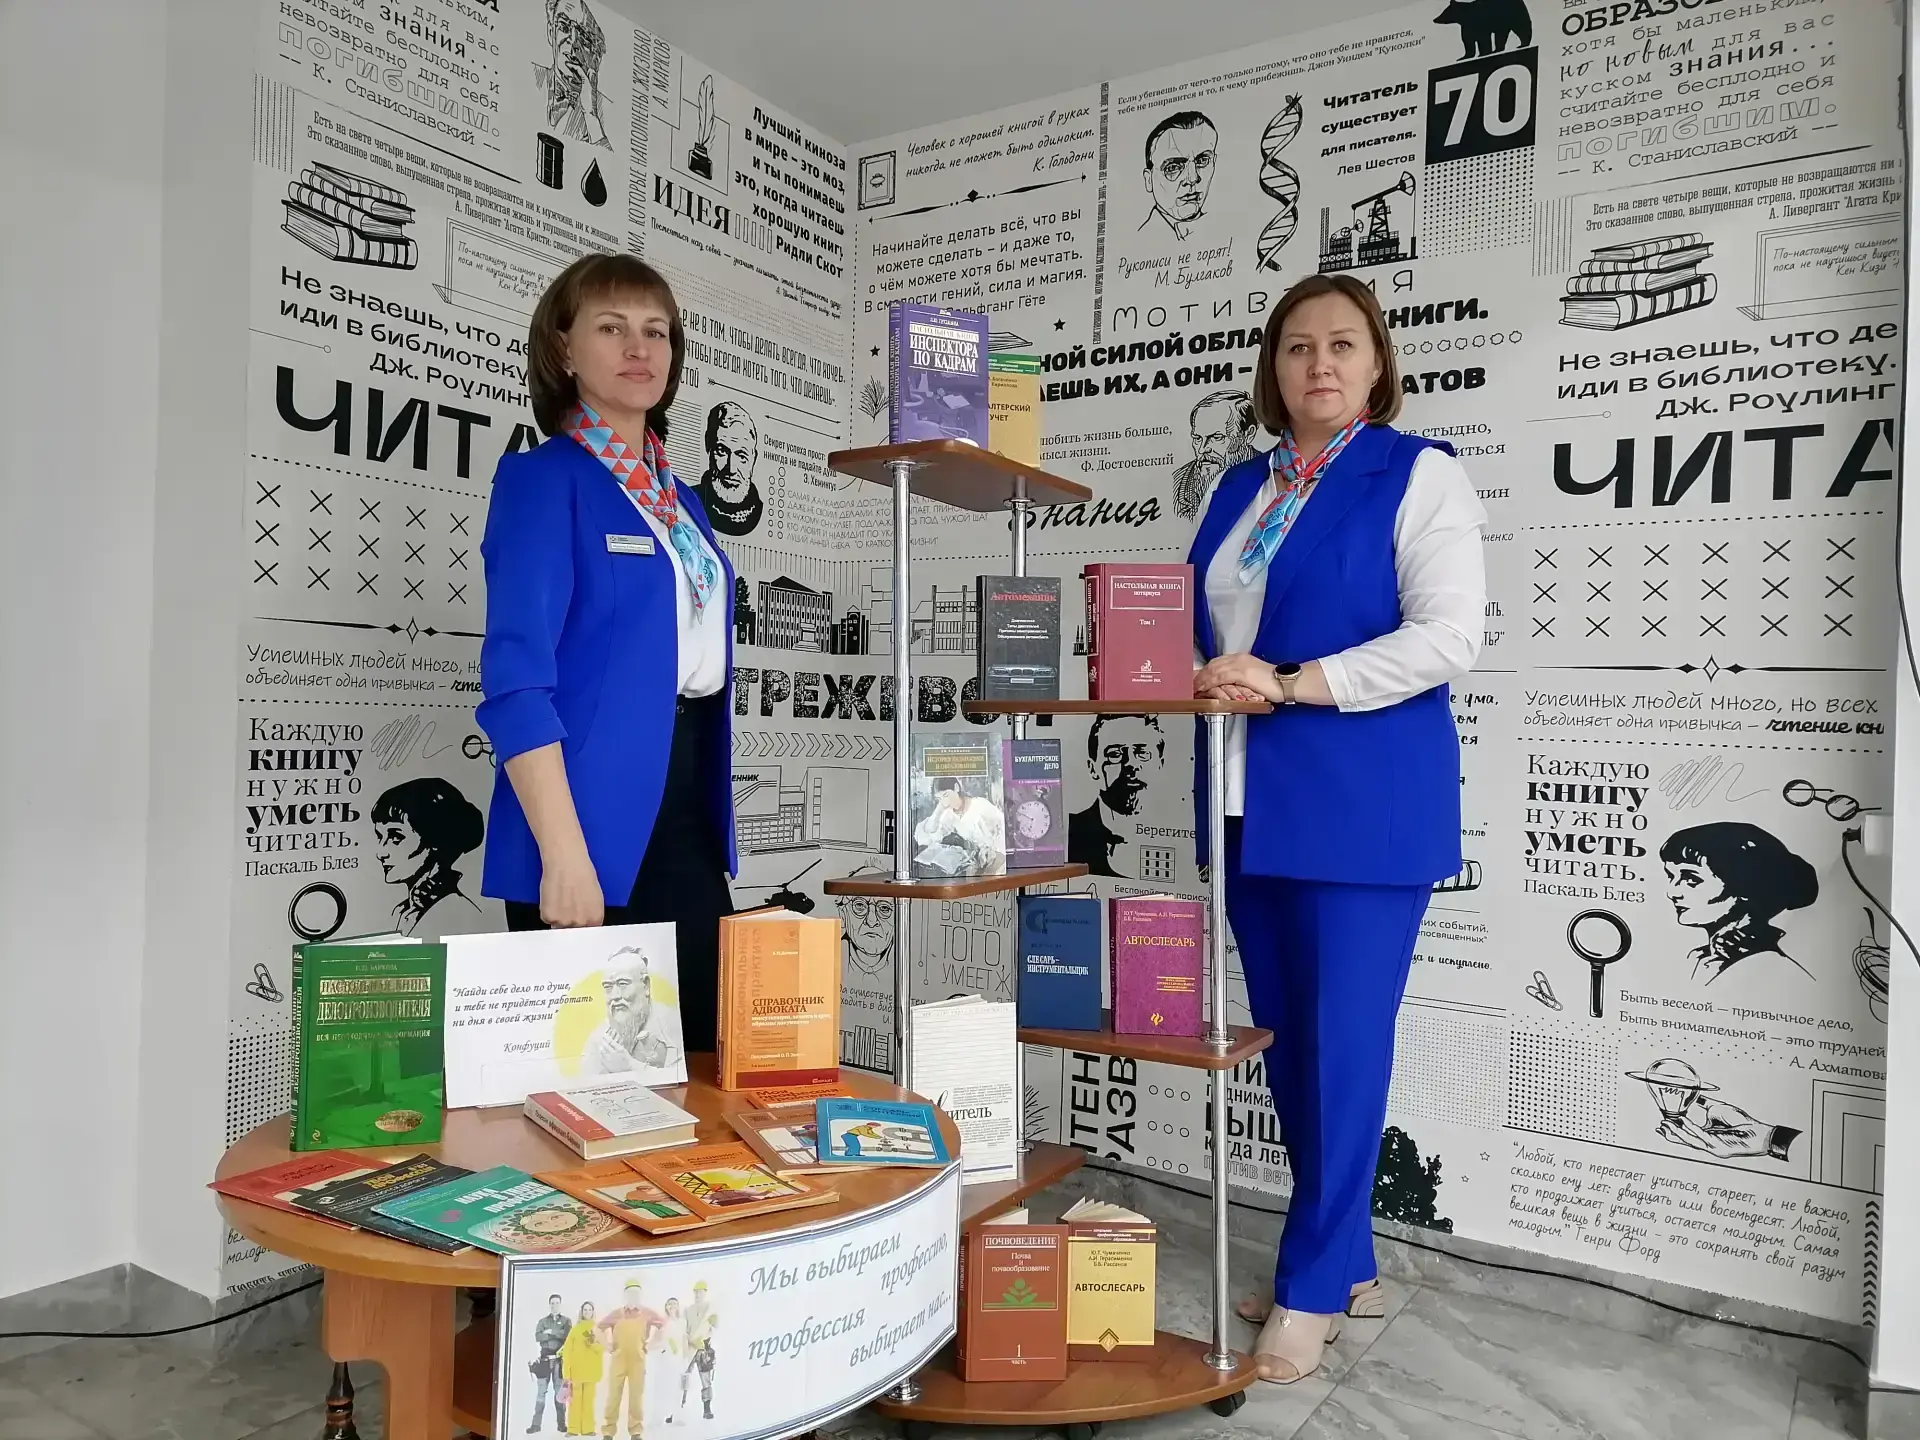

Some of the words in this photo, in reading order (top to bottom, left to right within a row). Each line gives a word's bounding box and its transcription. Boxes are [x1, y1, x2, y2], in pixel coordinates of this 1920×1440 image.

[1323, 80, 1418, 110] Читатель
[1559, 88, 1663, 118] считайте
[1678, 59, 1805, 95] бесплодно
[1821, 54, 1835, 68] и
[1560, 72, 1651, 99] куском
[1321, 104, 1418, 134] существует
[1435, 64, 1532, 147] 70
[753, 106, 801, 146] Лучший
[908, 140, 946, 157] Человек
[950, 139, 955, 147] с
[959, 125, 1004, 147] хорошей
[1008, 116, 1044, 133] книгой
[1048, 109, 1055, 125] в
[1057, 107, 1090, 125] руках
[1558, 97, 1837, 162] погибшим.
[906, 160, 946, 177] никогда
[949, 158, 961, 167] не
[964, 149, 1001, 164] может
[1006, 141, 1034, 155] быть
[1038, 128, 1094, 150] одиноким.
[1321, 143, 1345, 158] для
[1349, 130, 1417, 153] писателя.
[1592, 160, 1613, 174] К.
[1628, 125, 1798, 168] Станиславский
[1033, 157, 1044, 172] К.
[1049, 150, 1094, 169] Гольдони
[1337, 161, 1362, 177] Лев
[1365, 152, 1416, 172] Шестов
[653, 173, 731, 236] ИДЕЯ
[1769, 208, 1779, 219] А.
[1783, 201, 1839, 217] Ливергант
[753, 203, 809, 241] хорошую
[872, 234, 943, 256] Начинайте
[948, 225, 995, 244] делать
[1001, 217, 1028, 233] всё,
[1033, 213, 1055, 227] что
[1062, 208, 1081, 221] вы
[776, 235, 812, 265] Ридли
[1118, 255, 1172, 276] Рукописи
[1177, 252, 1191, 265] не
[1196, 237, 1233, 268] горят!
[1155, 271, 1171, 287] М.
[1174, 260, 1233, 290] Булгаков
[281, 265, 322, 294] Не
[330, 283, 449, 335] знаешь,
[455, 321, 500, 346] что
[1018, 293, 1046, 309] Гёте
[910, 335, 978, 358] ИНСПЕКТОРА
[1090, 333, 1185, 367] СИЛОЙ
[1559, 352, 1600, 373] Не
[1610, 339, 1759, 367] знаешь,
[1770, 329, 1839, 348] что
[914, 351, 930, 365] ПО
[935, 355, 976, 373] КАДРАМ
[1104, 374, 1147, 396] ИХ,
[1152, 376, 1170, 391] А
[1175, 365, 1233, 388] ОНИ
[1558, 379, 1617, 399] иди
[1628, 378, 1648, 392] в
[1658, 353, 1897, 389] библиотеку.
[1656, 396, 1718, 419] Дж.
[1729, 383, 1895, 413] Роулинг
[990, 414, 1008, 422] УЧЕТ
[1422, 422, 1492, 439] стыдно,
[764, 434, 785, 450] Секрет
[787, 440, 807, 459] успеха
[1083, 431, 1122, 444] жизнь
[1125, 424, 1172, 439] больше,
[1081, 460, 1094, 473] Ф.
[1097, 454, 1174, 471] Достоевский
[1525, 690, 1626, 709] Успешных
[1632, 690, 1701, 709] людей
[1711, 697, 1783, 714] много,
[1792, 697, 1816, 712] но
[1826, 699, 1878, 713] всех
[249, 718, 363, 746] Каждую
[248, 749, 363, 776] книгу
[247, 778, 362, 801] нужно
[246, 802, 360, 834] уметь
[1136, 824, 1196, 839] Берегите
[246, 831, 359, 853] читать.
[245, 860, 318, 877] Паскаль
[322, 857, 359, 871] Блез
[940, 924, 1005, 971] ТОГО,
[1124, 936, 1195, 947] АВТОСЛЕСАРЬ
[490, 985, 508, 995] себе
[511, 984, 530, 994] дело
[547, 982, 570, 993] душе,
[752, 997, 824, 1006] СПРАВОЧНИК
[317, 999, 431, 1025] ДЕЛОПРОИЗВОДИТЕЛЯ
[464, 1001, 486, 1011] тебе
[502, 998, 546, 1011] придётся
[548, 994, 593, 1008] работать
[752, 1005, 807, 1015] АДВОКАТА
[468, 1016, 485, 1026] дня
[496, 1014, 520, 1024] своей
[1732, 1006, 1814, 1028] привычное
[1818, 1016, 1854, 1032] дело,
[504, 1040, 550, 1053] Конфуций
[1789, 1056, 1805, 1069] А.
[1563, 1159, 1582, 1170] кто
[1589, 1163, 1646, 1183] перестает
[1652, 1176, 1700, 1194] учиться,
[1707, 1186, 1756, 1206] стареет,
[985, 1236, 1057, 1246] ПОЧВОВЕДЕНИЕ
[1575, 1226, 1612, 1248] Генри
[1619, 1236, 1660, 1263] Форд
[748, 1263, 799, 1295] Мы
[806, 1233, 901, 1282] выбираем
[881, 1233, 948, 1295] профессию,
[992, 1265, 1050, 1273] почвообразование
[1011, 1252, 1031, 1260] Почва
[749, 1308, 865, 1367] профессия
[850, 1307, 925, 1367] выбирает
[928, 1290, 951, 1321] нас...
[1016, 1344, 1022, 1358] 1
